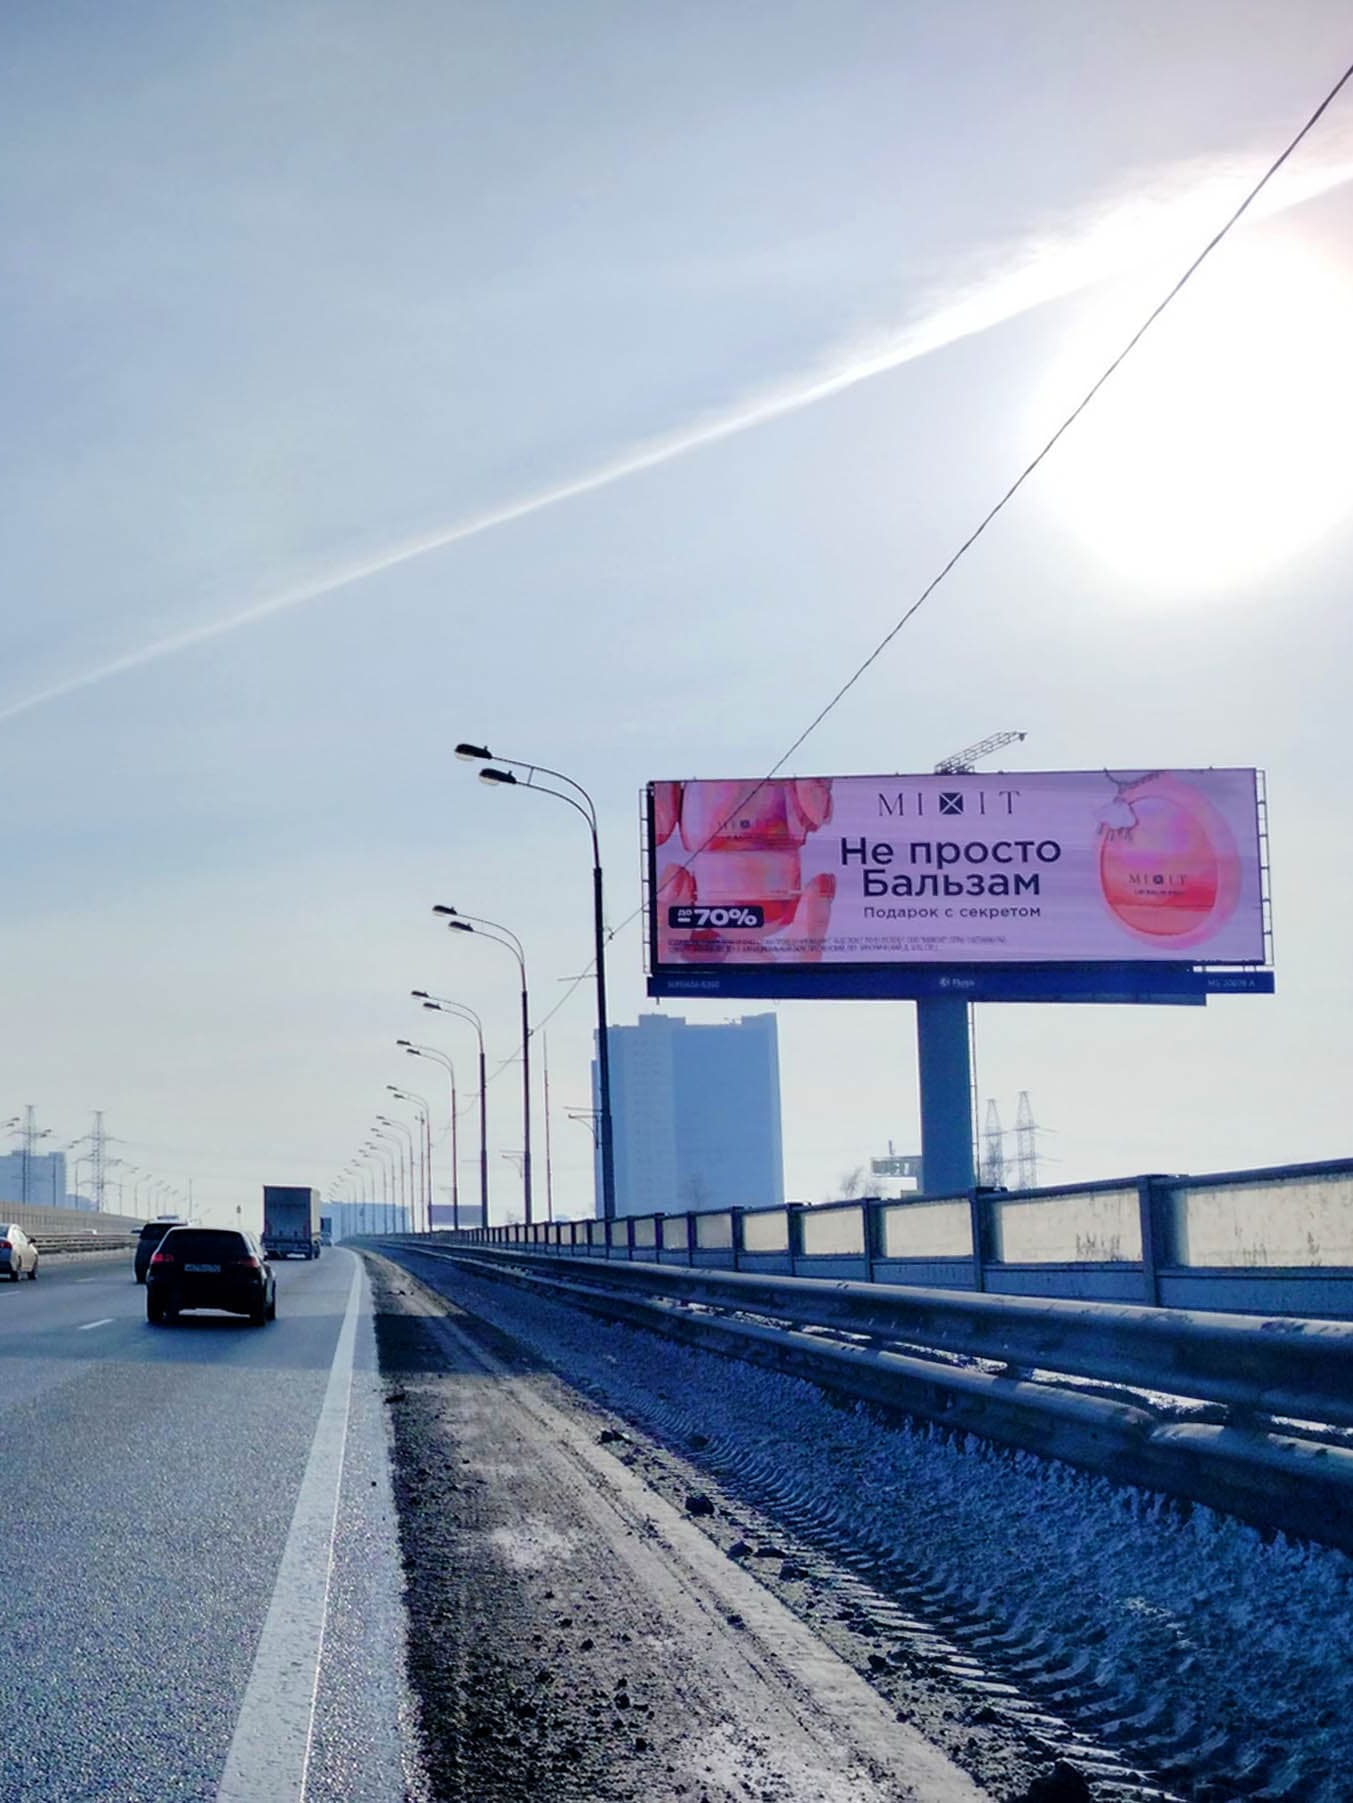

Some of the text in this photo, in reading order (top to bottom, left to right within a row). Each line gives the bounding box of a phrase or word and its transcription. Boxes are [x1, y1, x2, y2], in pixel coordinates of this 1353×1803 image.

[840, 837, 1061, 869] Не просто
[862, 869, 1040, 897] Бальзам
[863, 906, 1041, 919] Подарок с секретом
